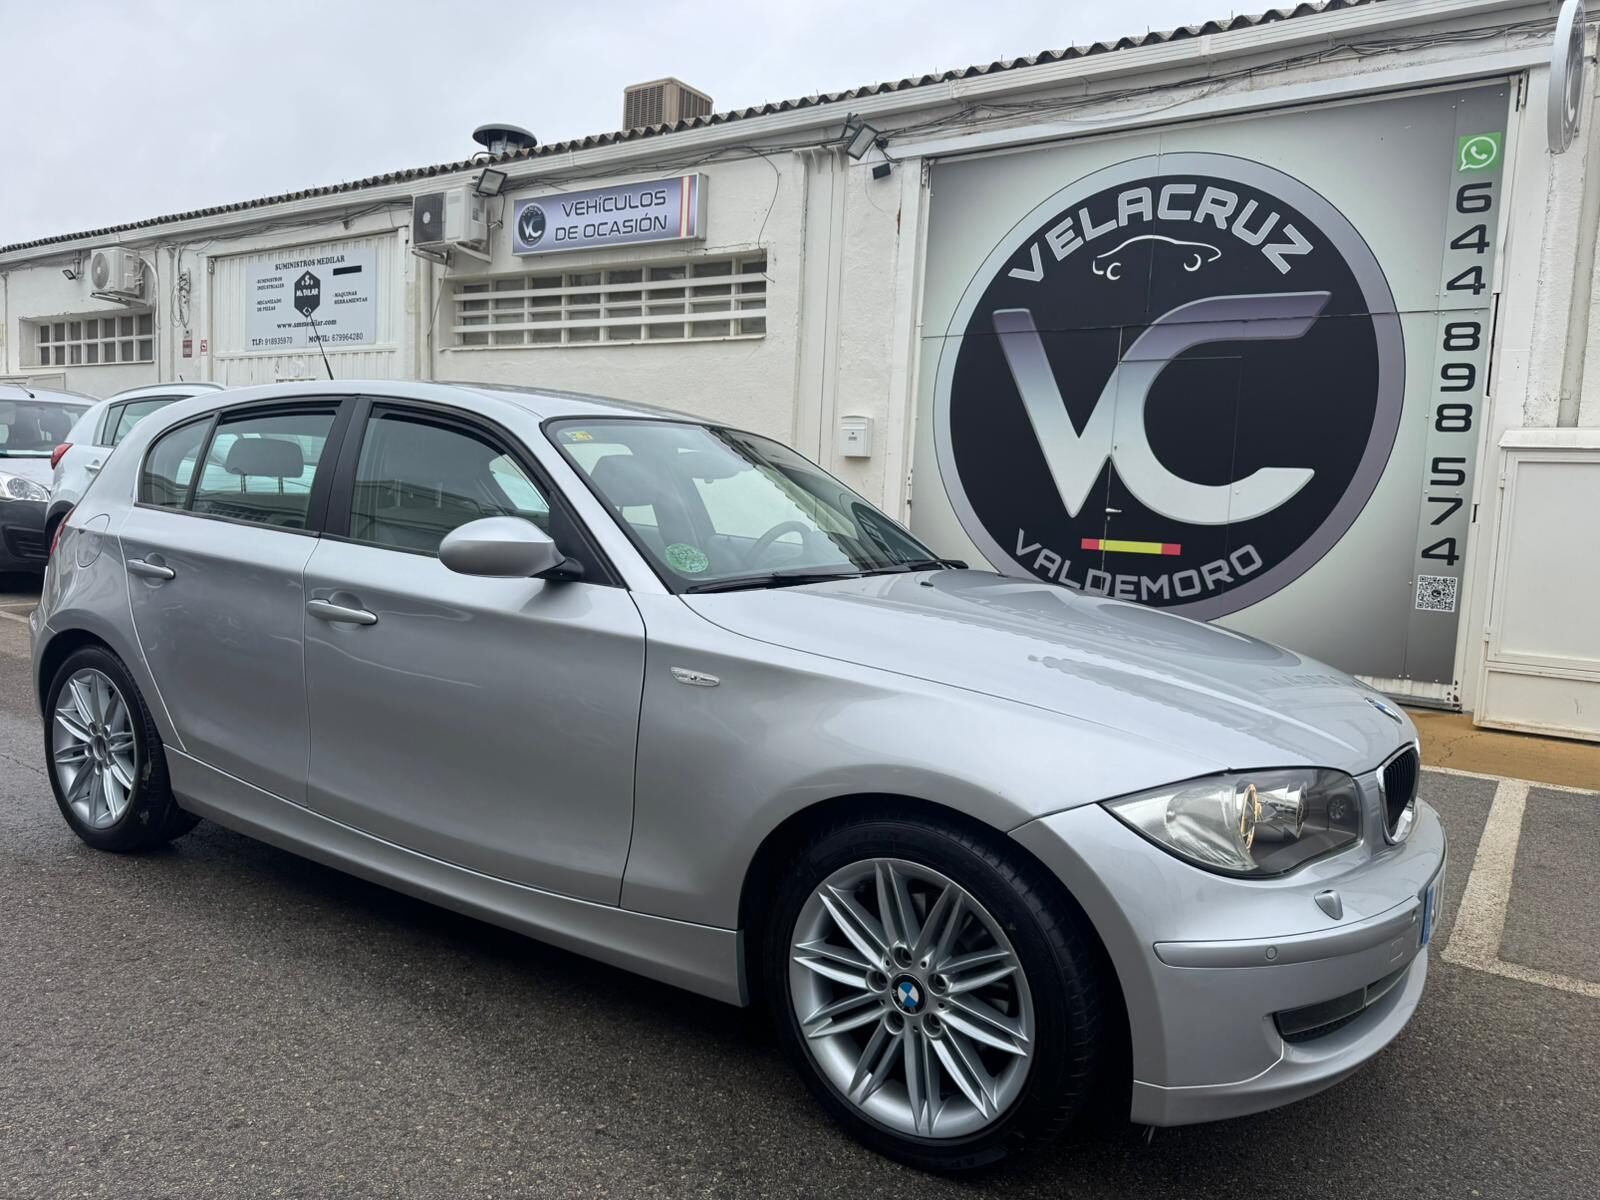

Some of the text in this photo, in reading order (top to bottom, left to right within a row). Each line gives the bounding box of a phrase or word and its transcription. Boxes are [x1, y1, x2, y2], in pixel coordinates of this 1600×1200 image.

[555, 213, 668, 241] DE OCASIÓN
[561, 190, 667, 217] VEHÍCULOS
[1008, 184, 1314, 282] VELACRUZ
[275, 255, 345, 271] SUMINISTROS MEDILAR
[993, 291, 1333, 525] VC
[1421, 182, 1493, 566] 644 898 574
[1016, 528, 1264, 600] VALDEMORO
